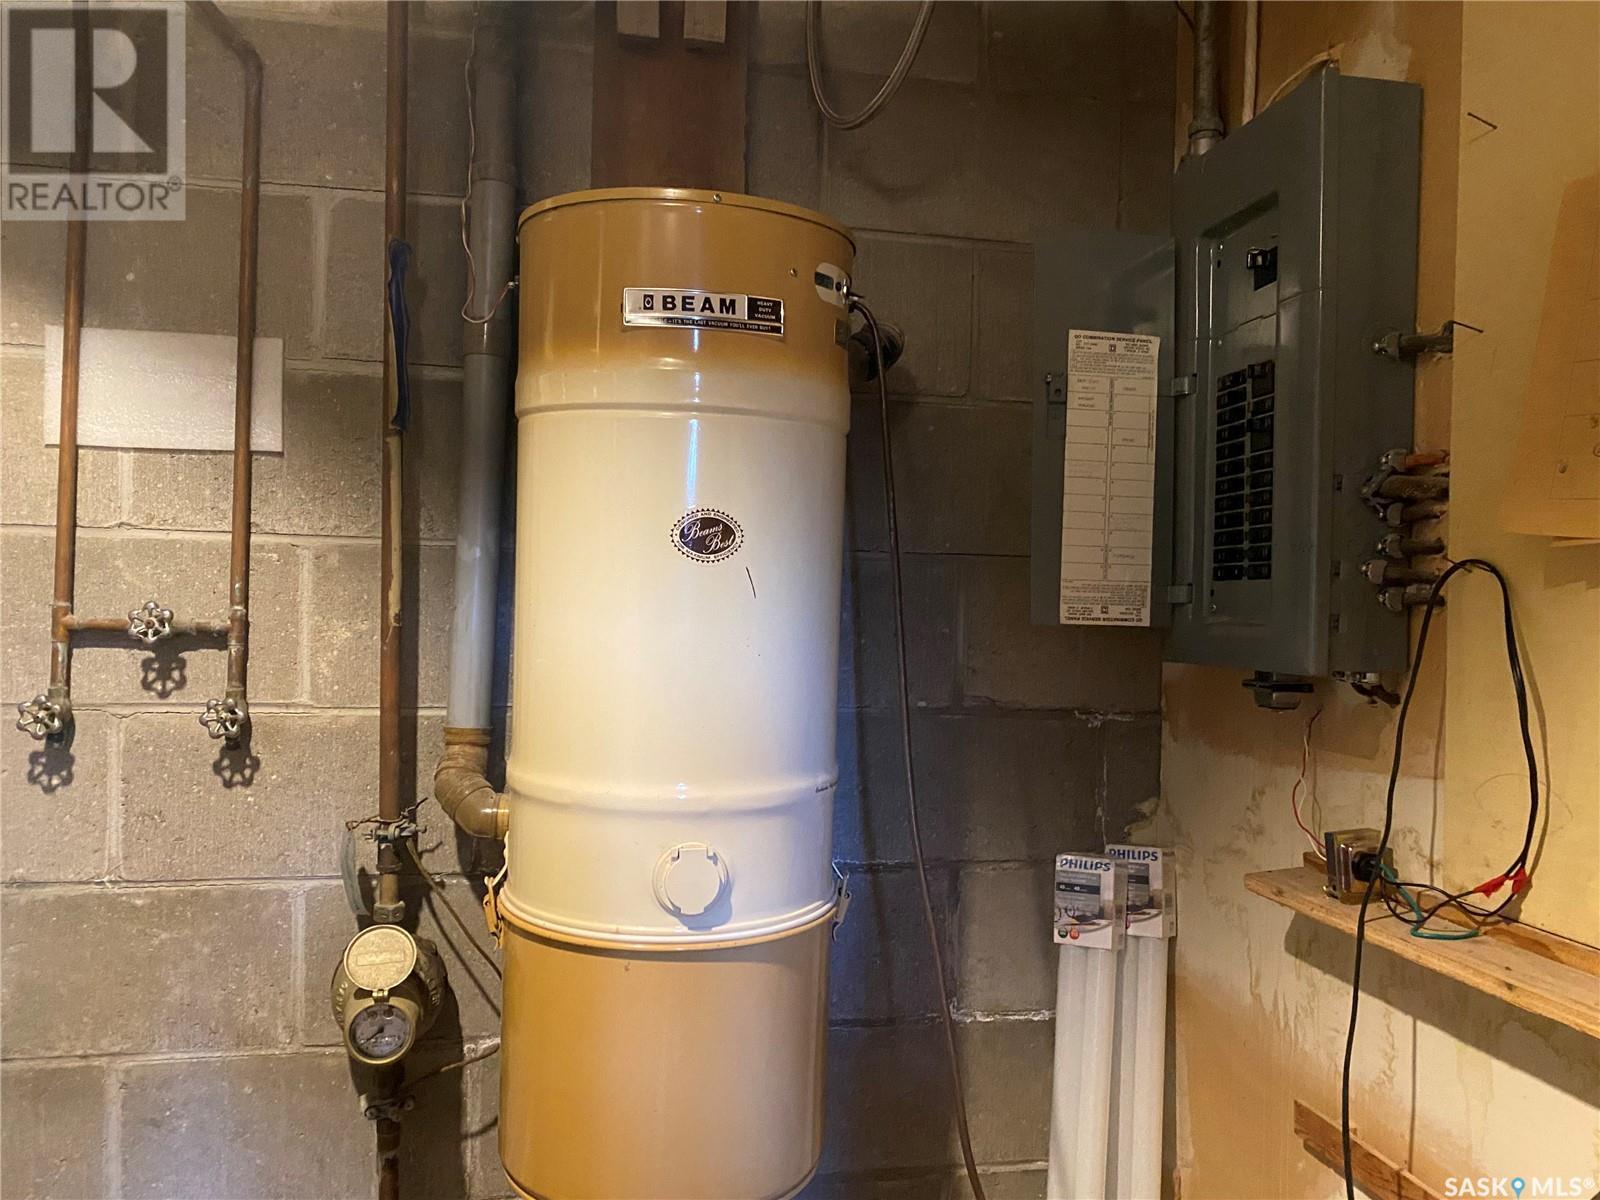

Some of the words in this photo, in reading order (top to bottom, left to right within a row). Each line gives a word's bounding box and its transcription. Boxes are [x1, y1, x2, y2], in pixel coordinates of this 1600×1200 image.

[662, 295, 737, 315] BEAM
[682, 519, 723, 542] Beams
[703, 532, 735, 553] Best
[1060, 857, 1111, 872] PHILIPS
[1108, 848, 1159, 861] PHILIPS
